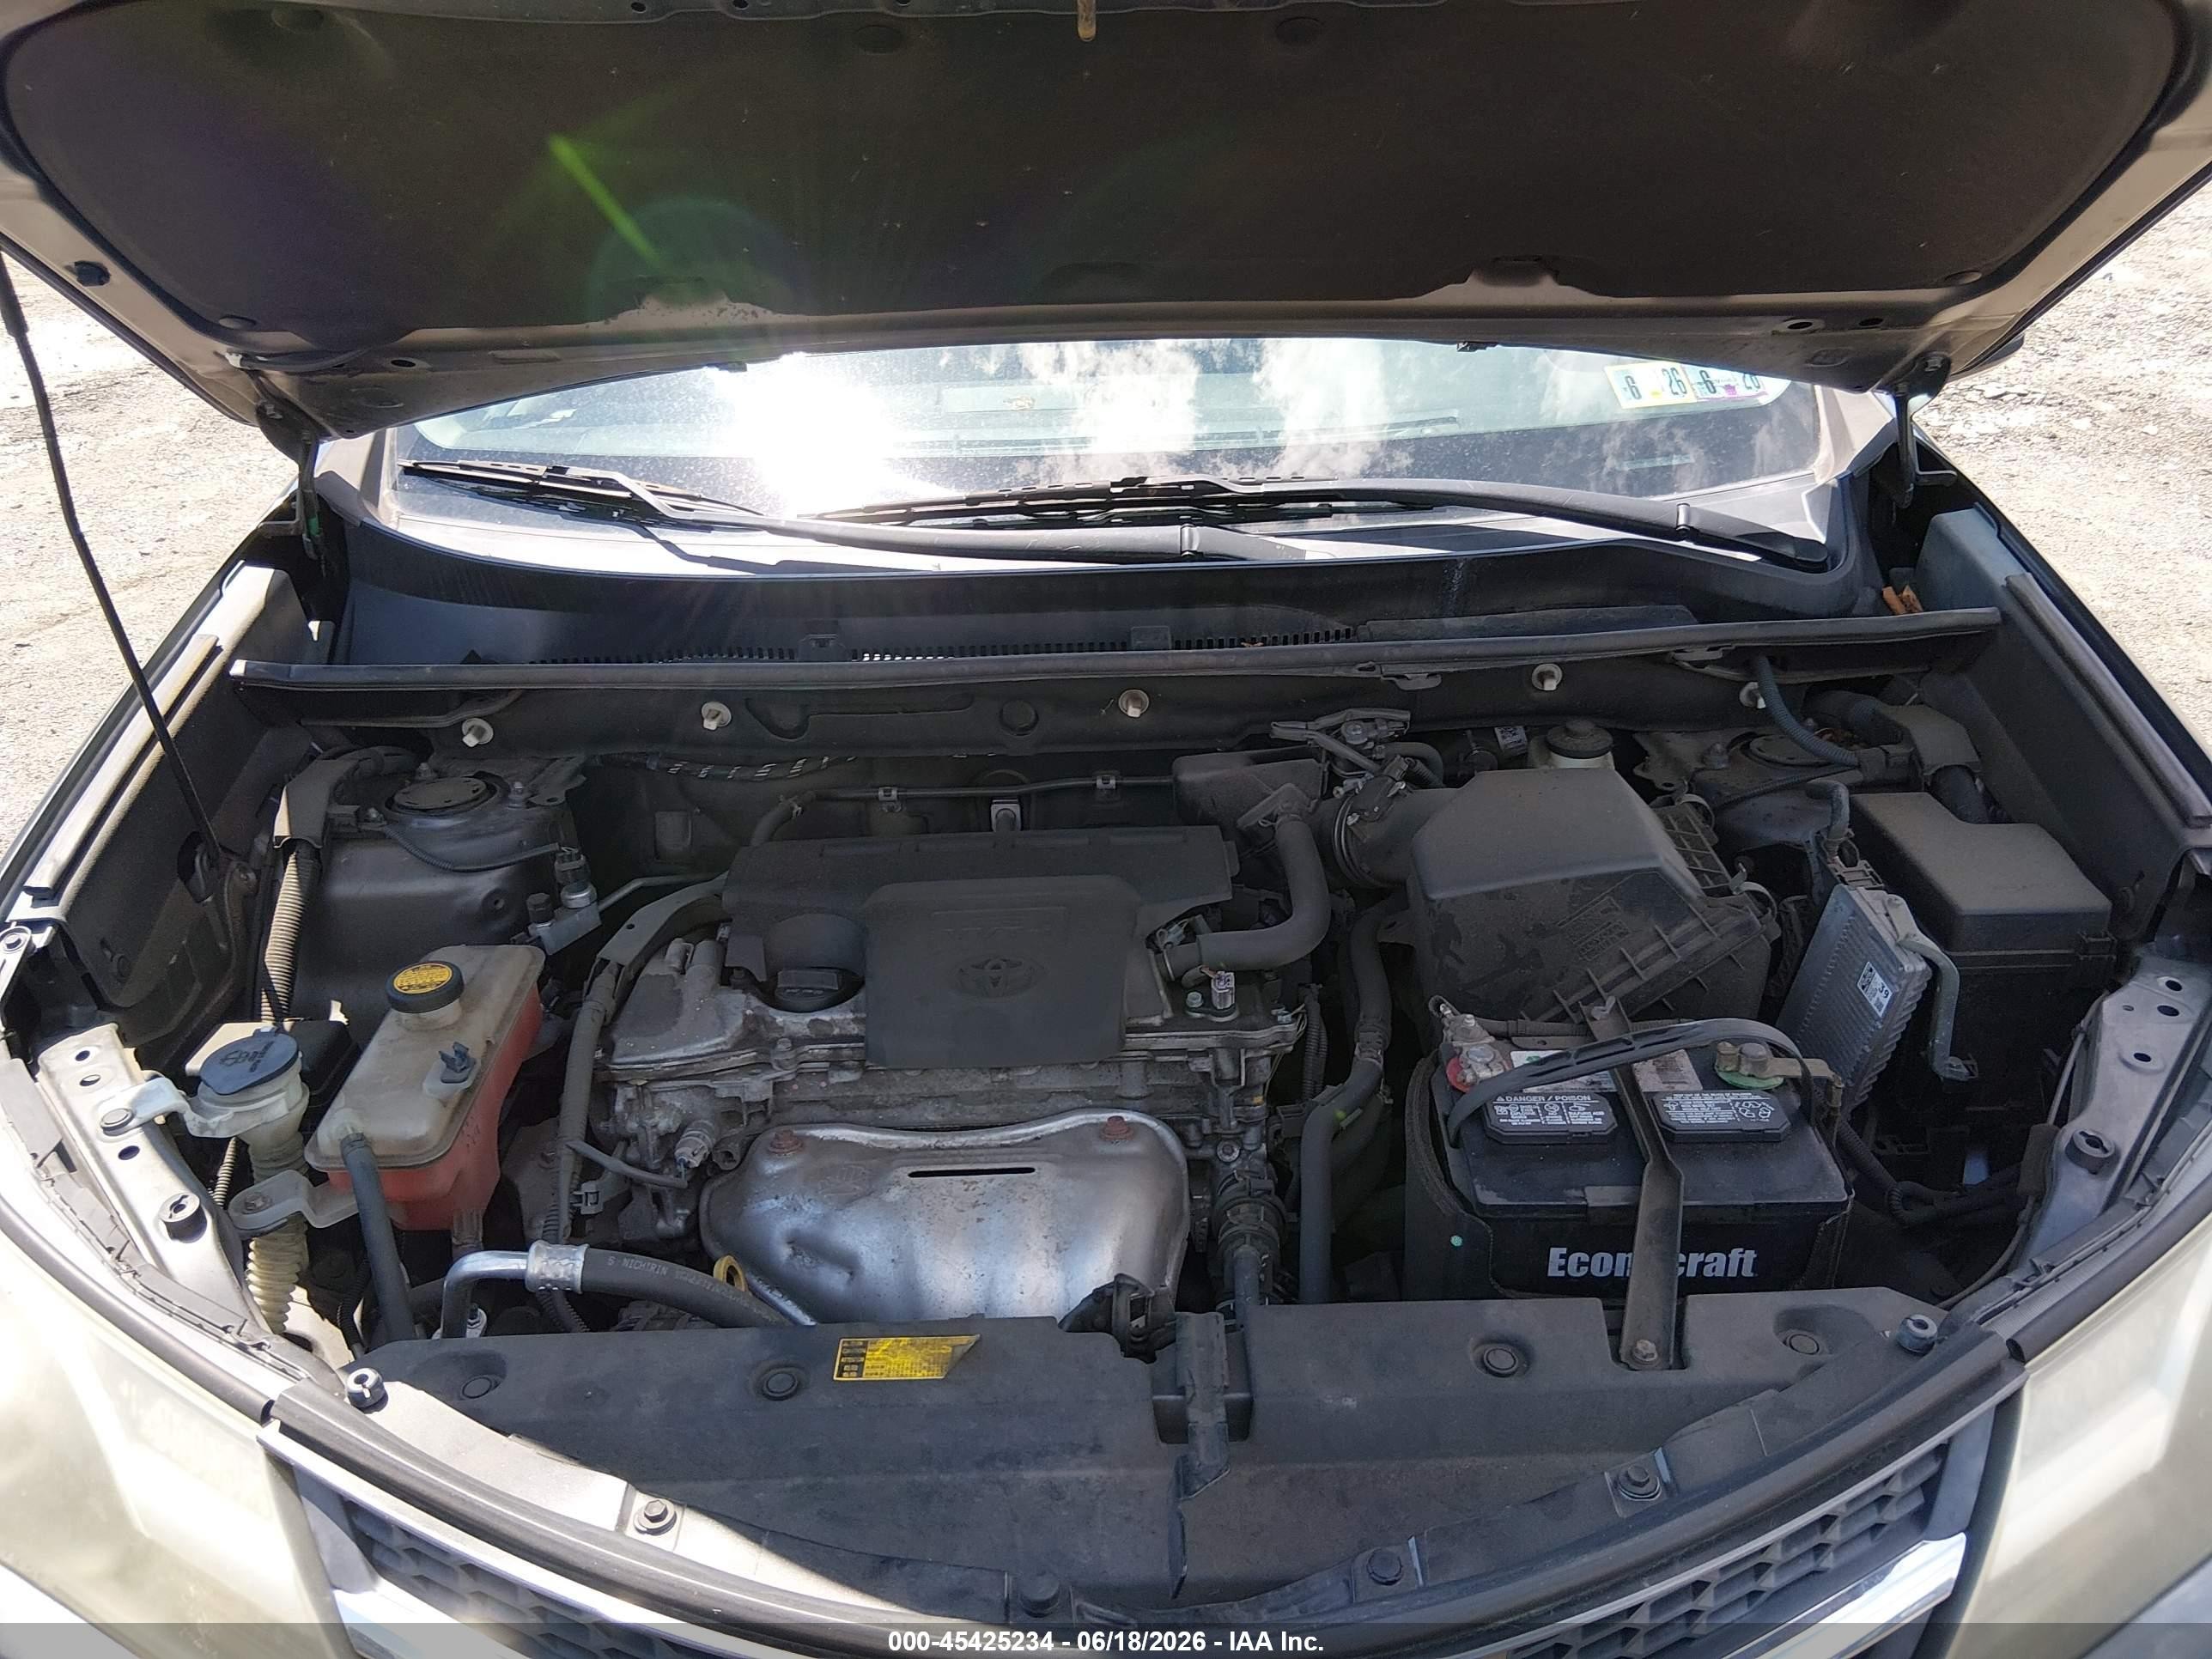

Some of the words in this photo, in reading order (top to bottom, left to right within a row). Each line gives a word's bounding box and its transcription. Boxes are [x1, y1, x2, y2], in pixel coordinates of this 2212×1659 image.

[1625, 375, 1642, 399] 6
[1662, 368, 1687, 395] 26
[1698, 369, 1717, 394] 6
[1547, 1247, 1758, 1277] Econraft
